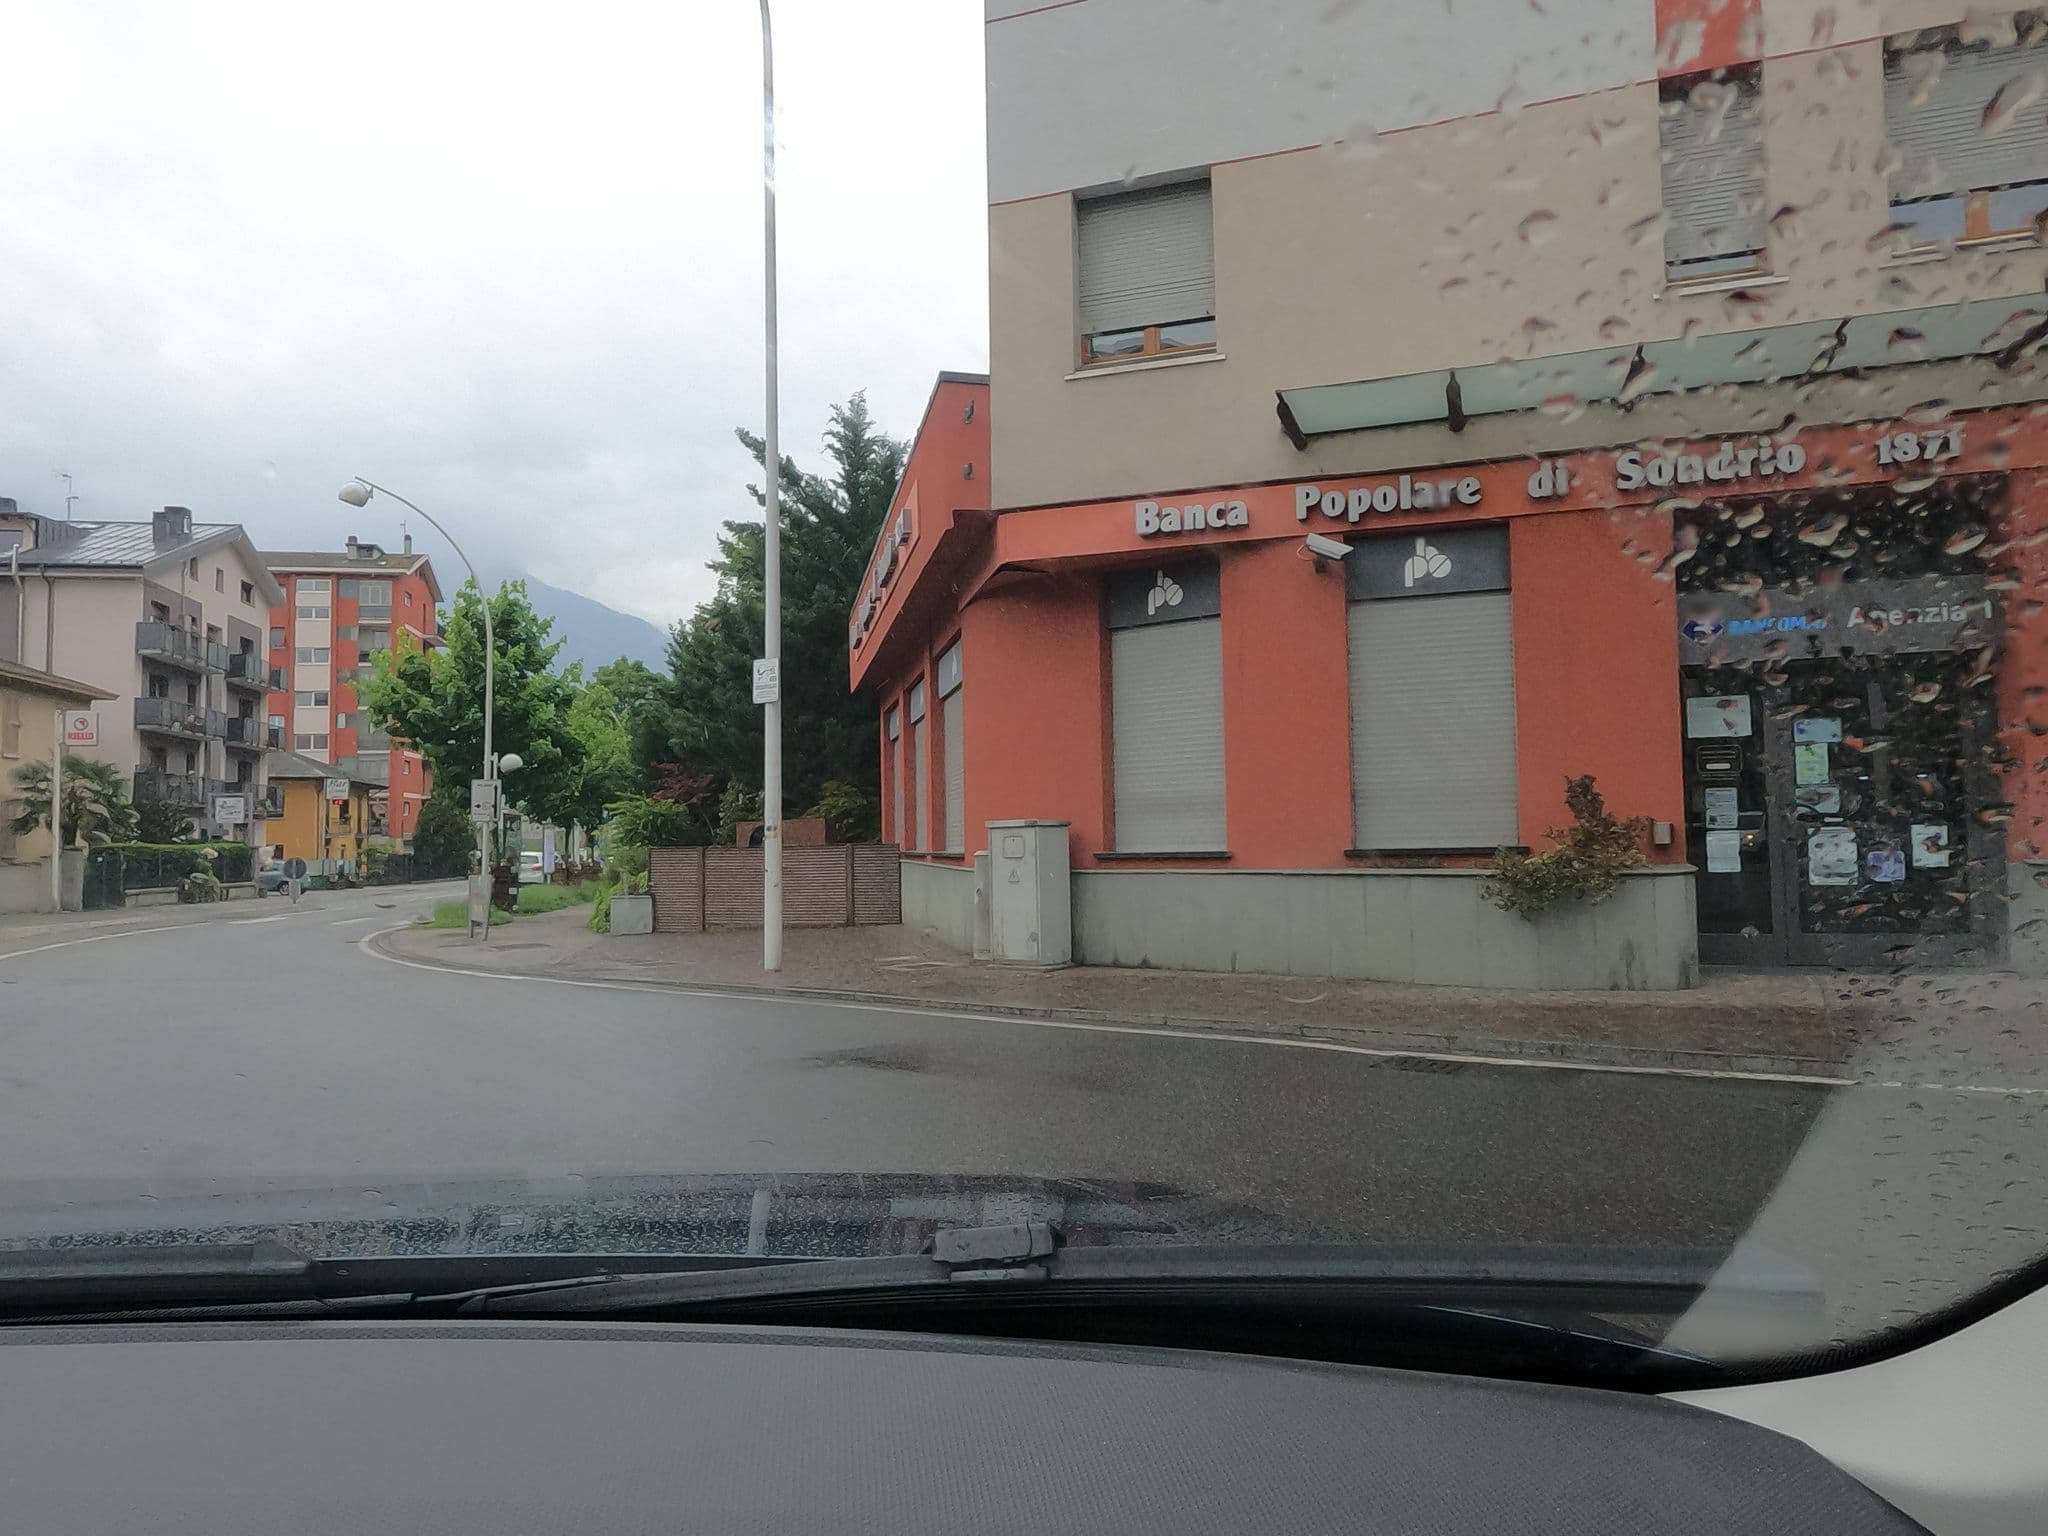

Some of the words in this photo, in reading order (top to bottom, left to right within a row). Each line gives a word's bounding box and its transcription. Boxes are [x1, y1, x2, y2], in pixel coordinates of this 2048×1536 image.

[1135, 498, 1248, 536] Banca
[1295, 474, 1482, 522] Popolare
[1528, 457, 1569, 498] di
[1615, 435, 1807, 490] Sondrio
[1876, 421, 1964, 464] 1871
